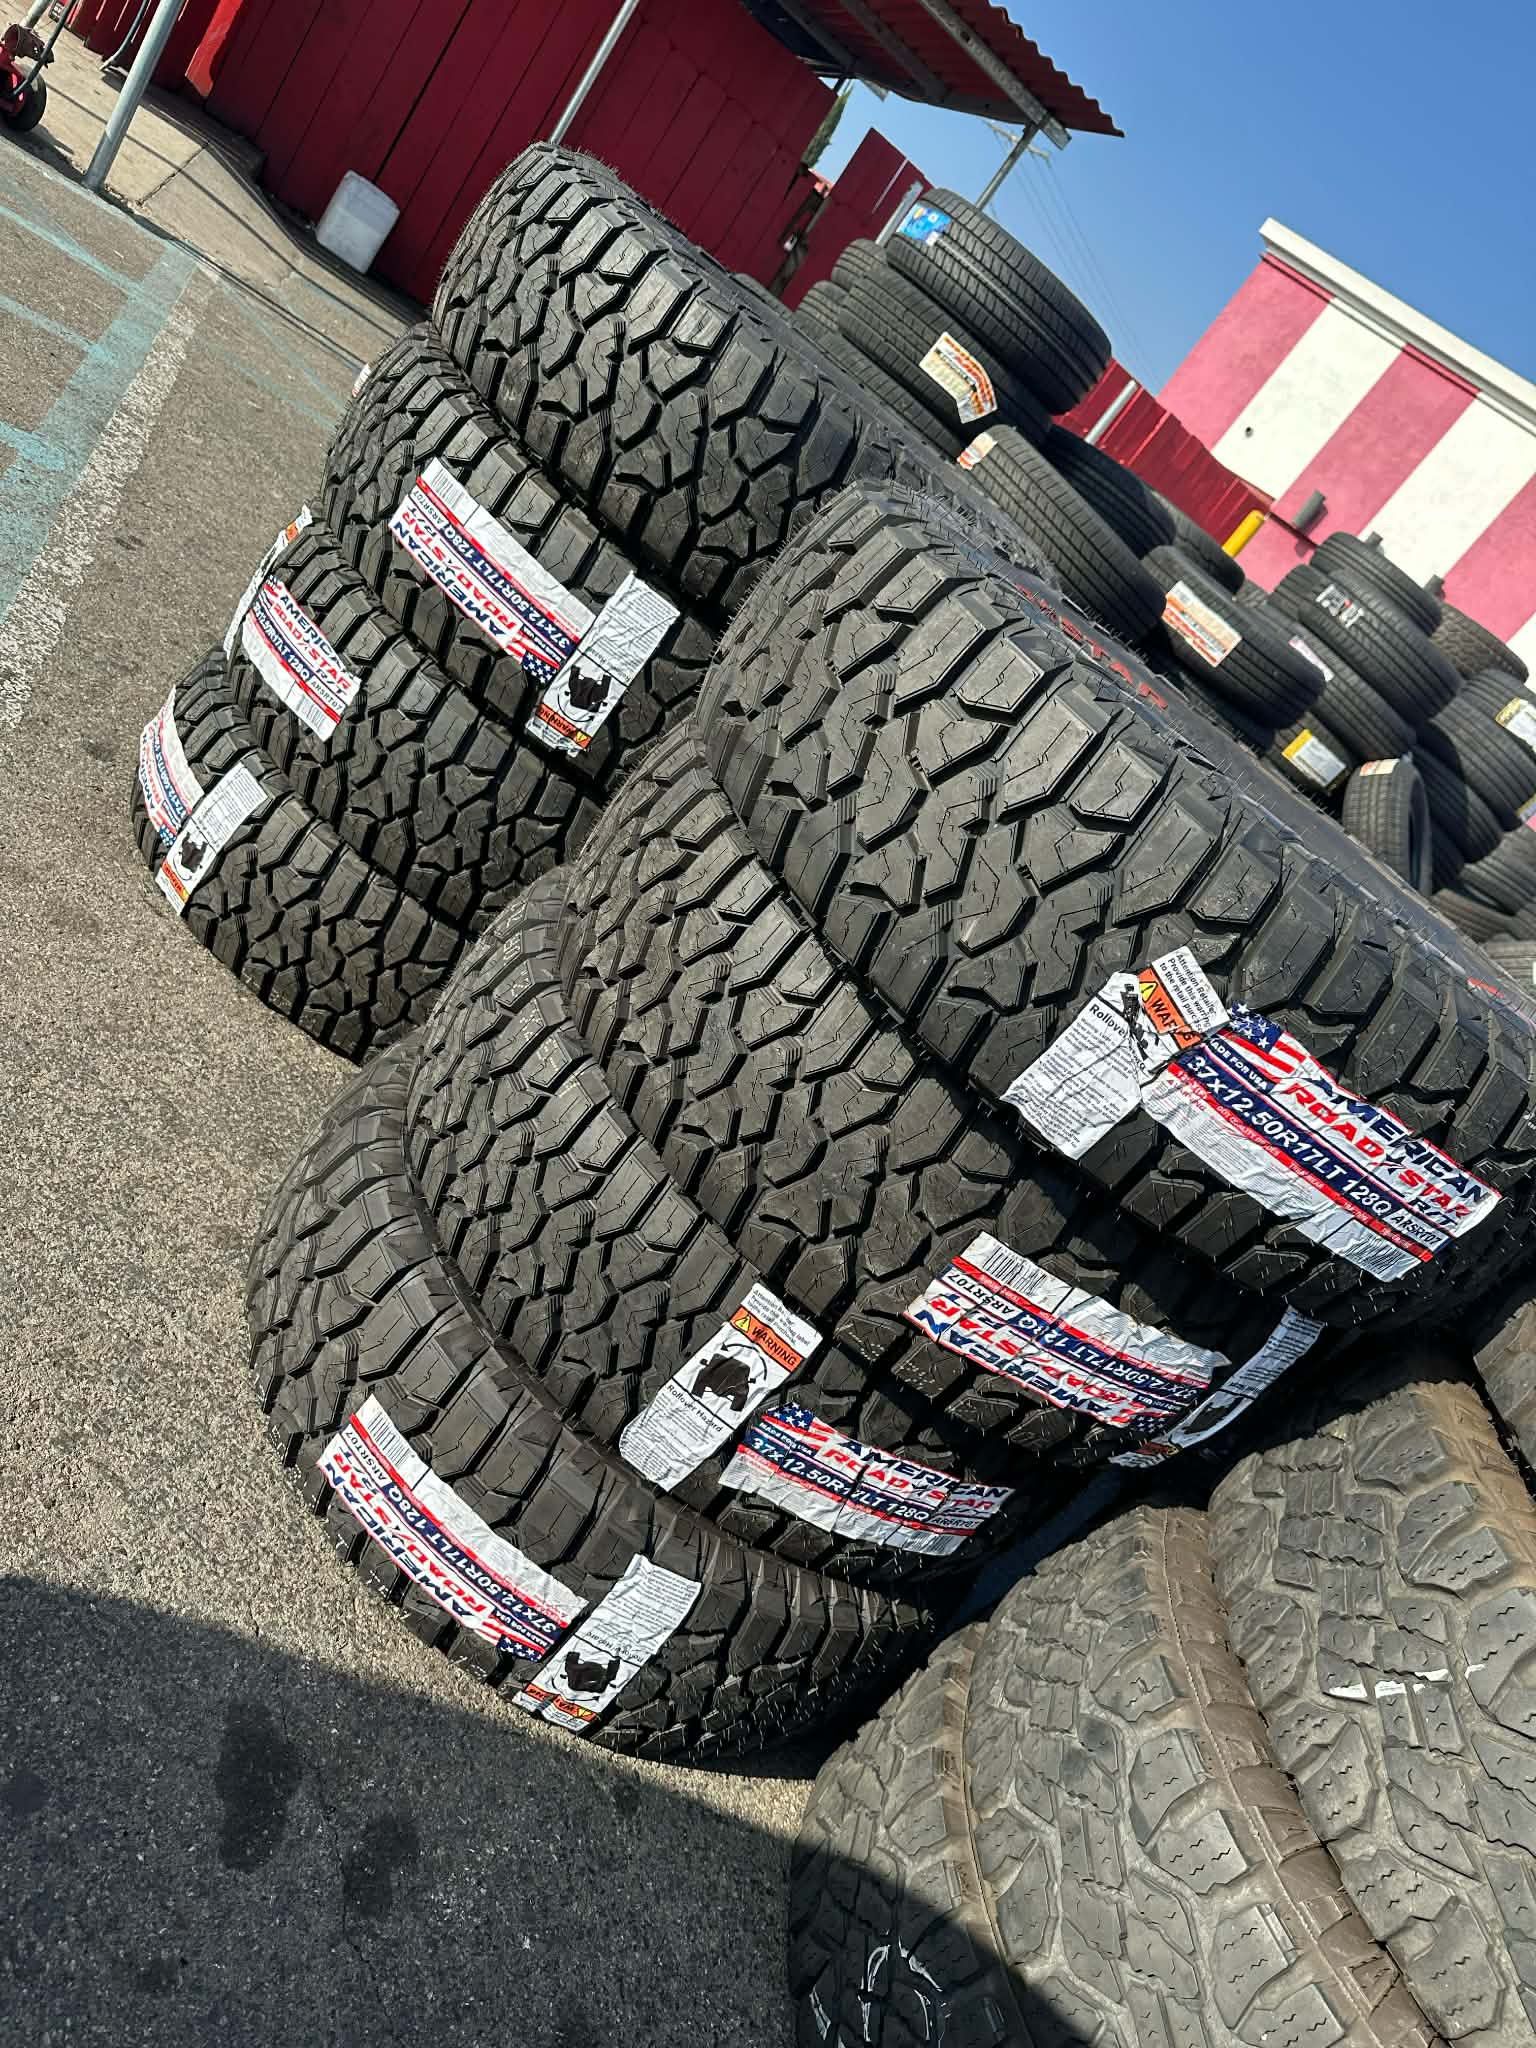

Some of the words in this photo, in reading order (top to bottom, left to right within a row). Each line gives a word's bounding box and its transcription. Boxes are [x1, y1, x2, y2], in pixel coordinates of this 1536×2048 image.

[401, 510, 445, 561] STAR
[442, 525, 475, 558] 128Q
[392, 521, 504, 635] AMERICAN
[455, 573, 516, 626] ROAD
[472, 556, 570, 648] 37x12.50R17LT
[285, 654, 311, 680] 128Q
[1159, 962, 1167, 971] to
[1164, 970, 1176, 984] the
[1172, 983, 1188, 1003] retail
[1167, 958, 1189, 987] Provide
[1184, 985, 1197, 1000] this
[1209, 1038, 1231, 1058] ADE
[1229, 1055, 1249, 1073] FOR
[1248, 1070, 1267, 1090] USA
[1185, 1055, 1346, 1180] 37x12.50R17LT
[1341, 1182, 1392, 1215] 128Q
[1391, 1215, 1441, 1246] ARSRT07
[1280, 1082, 1385, 1159] ROAD
[1397, 1167, 1472, 1220] STAR
[1302, 1076, 1487, 1202] AMERICAN
[946, 1271, 1014, 1314] ARSRT07
[751, 1326, 796, 1365] WARNING
[928, 1296, 1022, 1354] STAR
[915, 1309, 1109, 1412] AMERICAN
[666, 1384, 698, 1412] Rollover
[343, 1430, 387, 1480] ARSRT07
[331, 1453, 393, 1525] STAR
[386, 1484, 429, 1530] 128Q
[886, 1502, 929, 1521] 128Q
[322, 1462, 473, 1618] AMERICAN
[406, 1543, 485, 1612] ROAD
[424, 1527, 557, 1633] 37x12.50R17LT
[494, 1609, 512, 1624] USA
